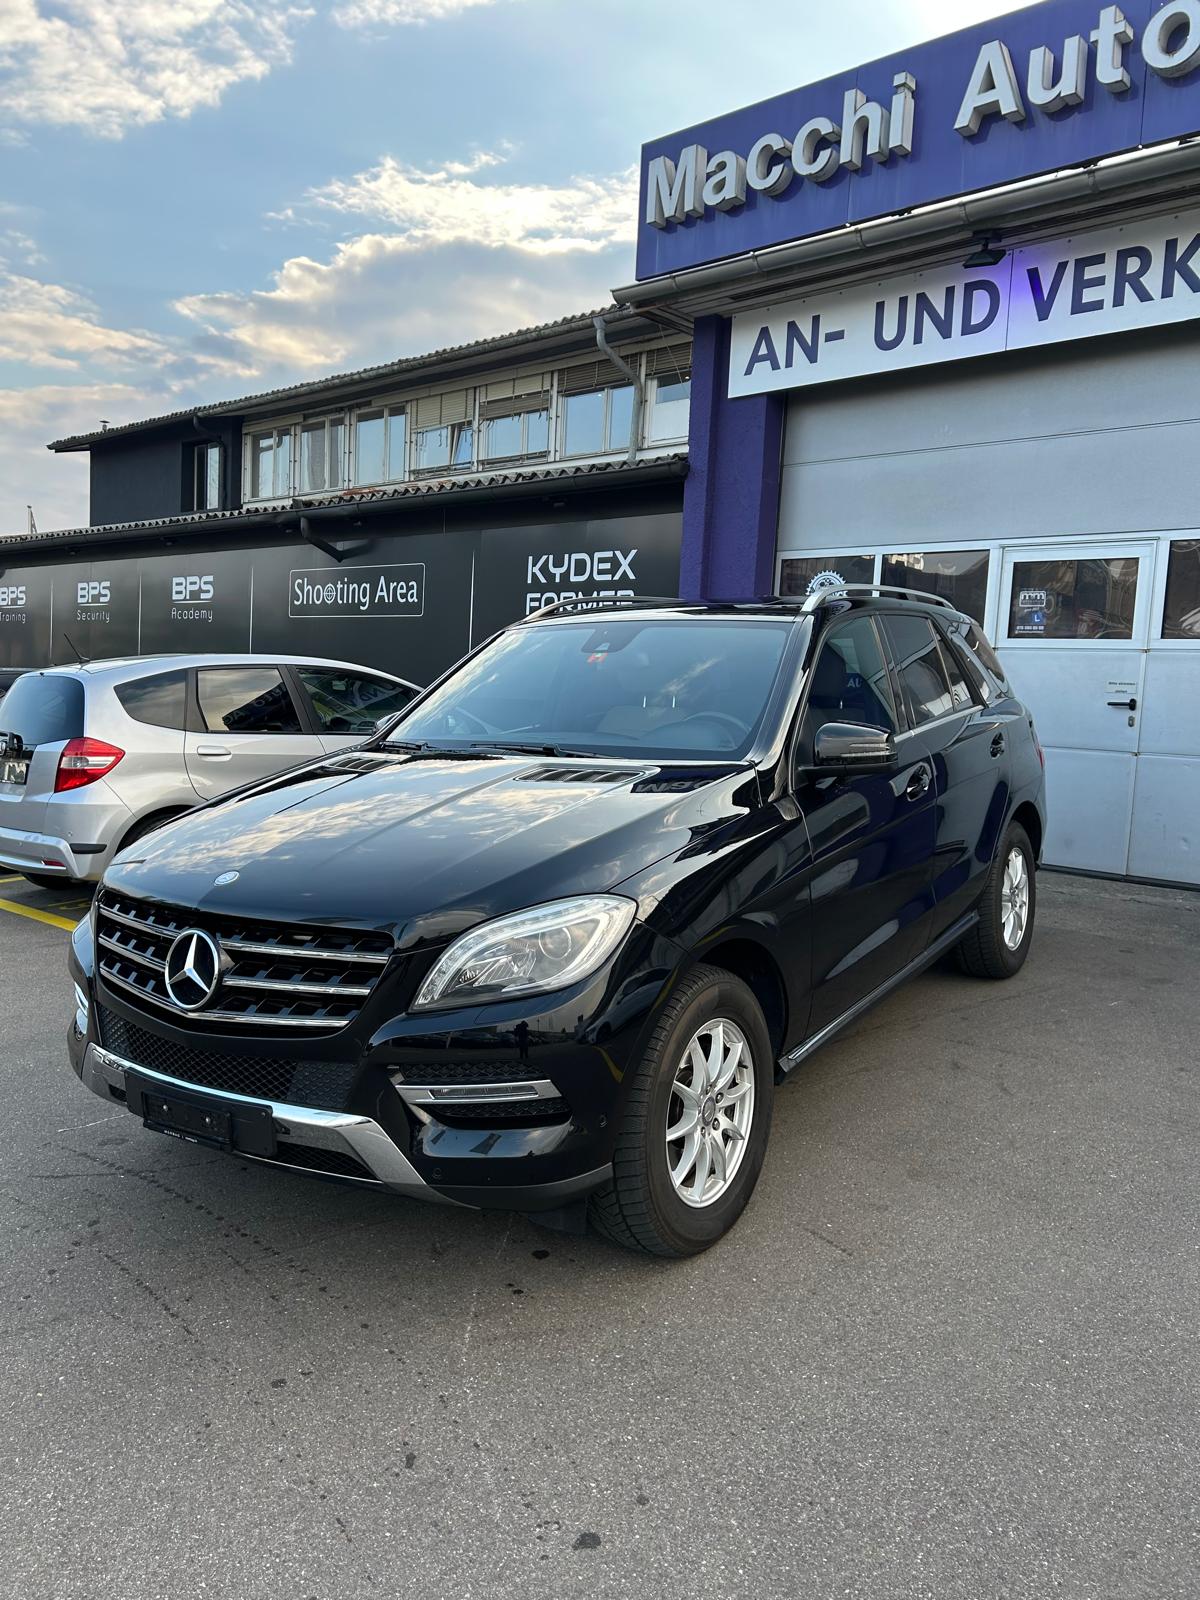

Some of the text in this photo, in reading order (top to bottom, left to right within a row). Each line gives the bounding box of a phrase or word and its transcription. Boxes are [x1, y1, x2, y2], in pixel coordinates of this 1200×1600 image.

[646, 0, 1200, 229] Macchi Auto
[743, 232, 1200, 377] AN- UND VERK
[527, 549, 638, 584] KYDEX
[0, 586, 26, 606] BPS
[77, 581, 111, 603] BPS
[172, 575, 214, 600] BPS
[374, 575, 418, 603] Area
[76, 610, 111, 623] Security
[171, 607, 213, 623] Academy
